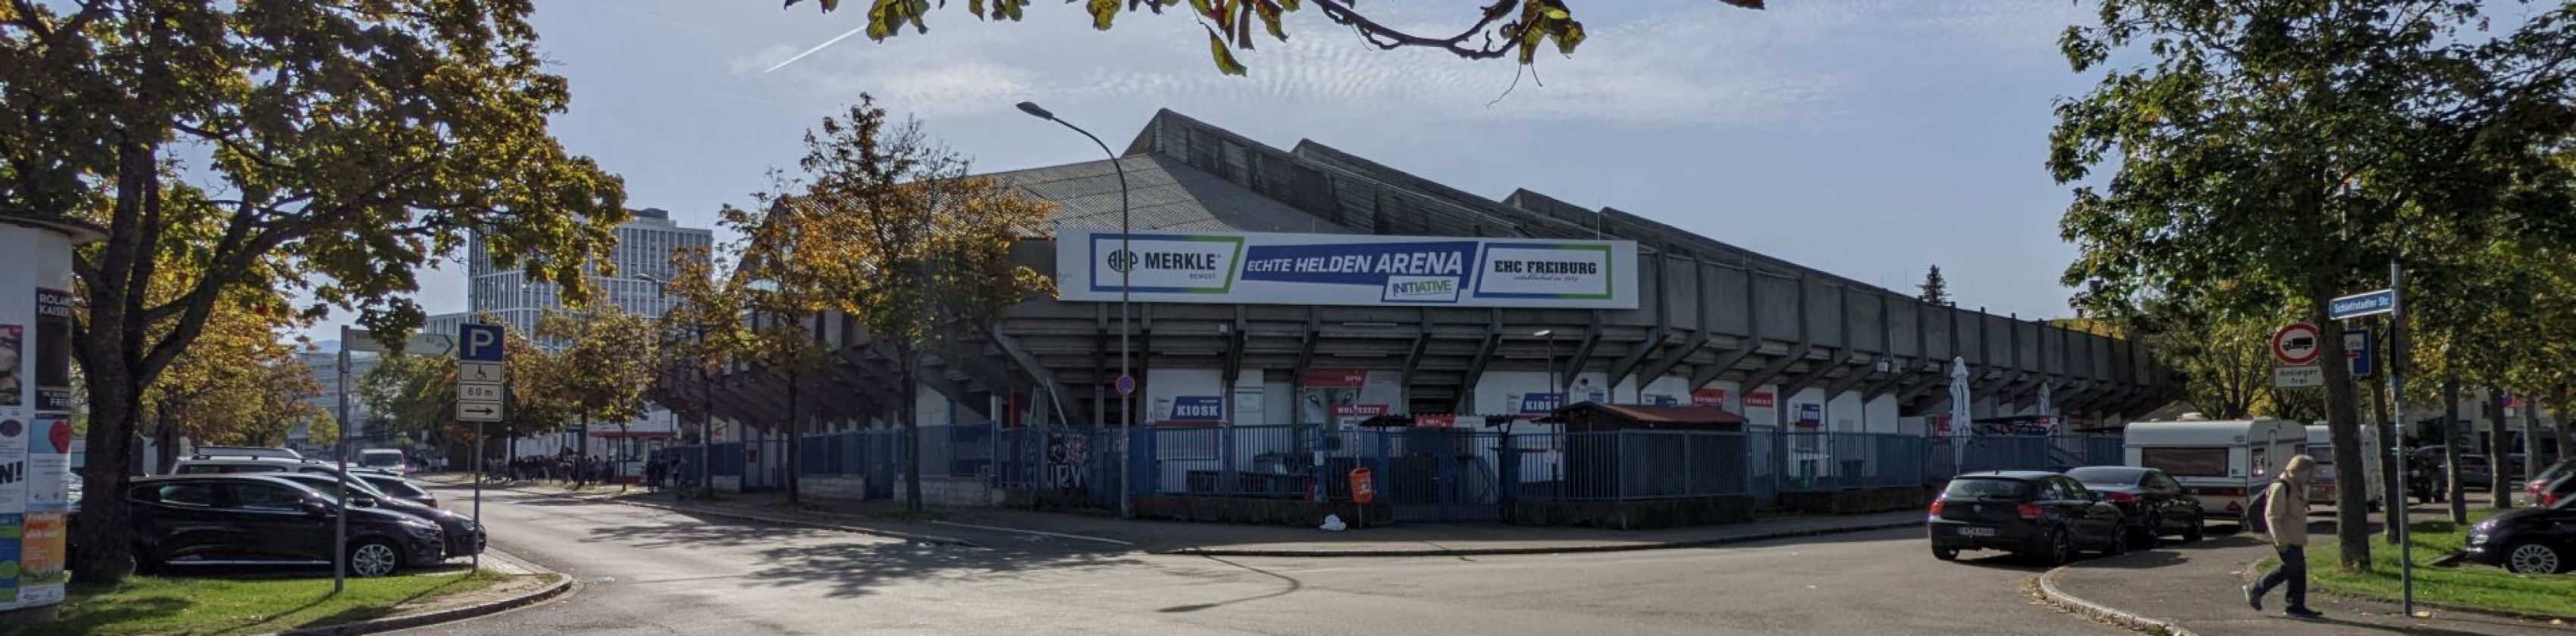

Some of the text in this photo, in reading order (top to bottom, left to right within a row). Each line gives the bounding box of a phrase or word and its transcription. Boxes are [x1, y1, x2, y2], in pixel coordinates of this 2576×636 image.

[1145, 252, 1216, 270] MERKLE
[1247, 251, 1463, 274] ECHTE HELDEN ARENA
[1494, 260, 1597, 275] EHC FREIBURG
[1393, 279, 1452, 296] INITIATIVE
[39, 294, 70, 304] ROLAN
[470, 329, 494, 357] P
[1177, 405, 1218, 416] KIOSK
